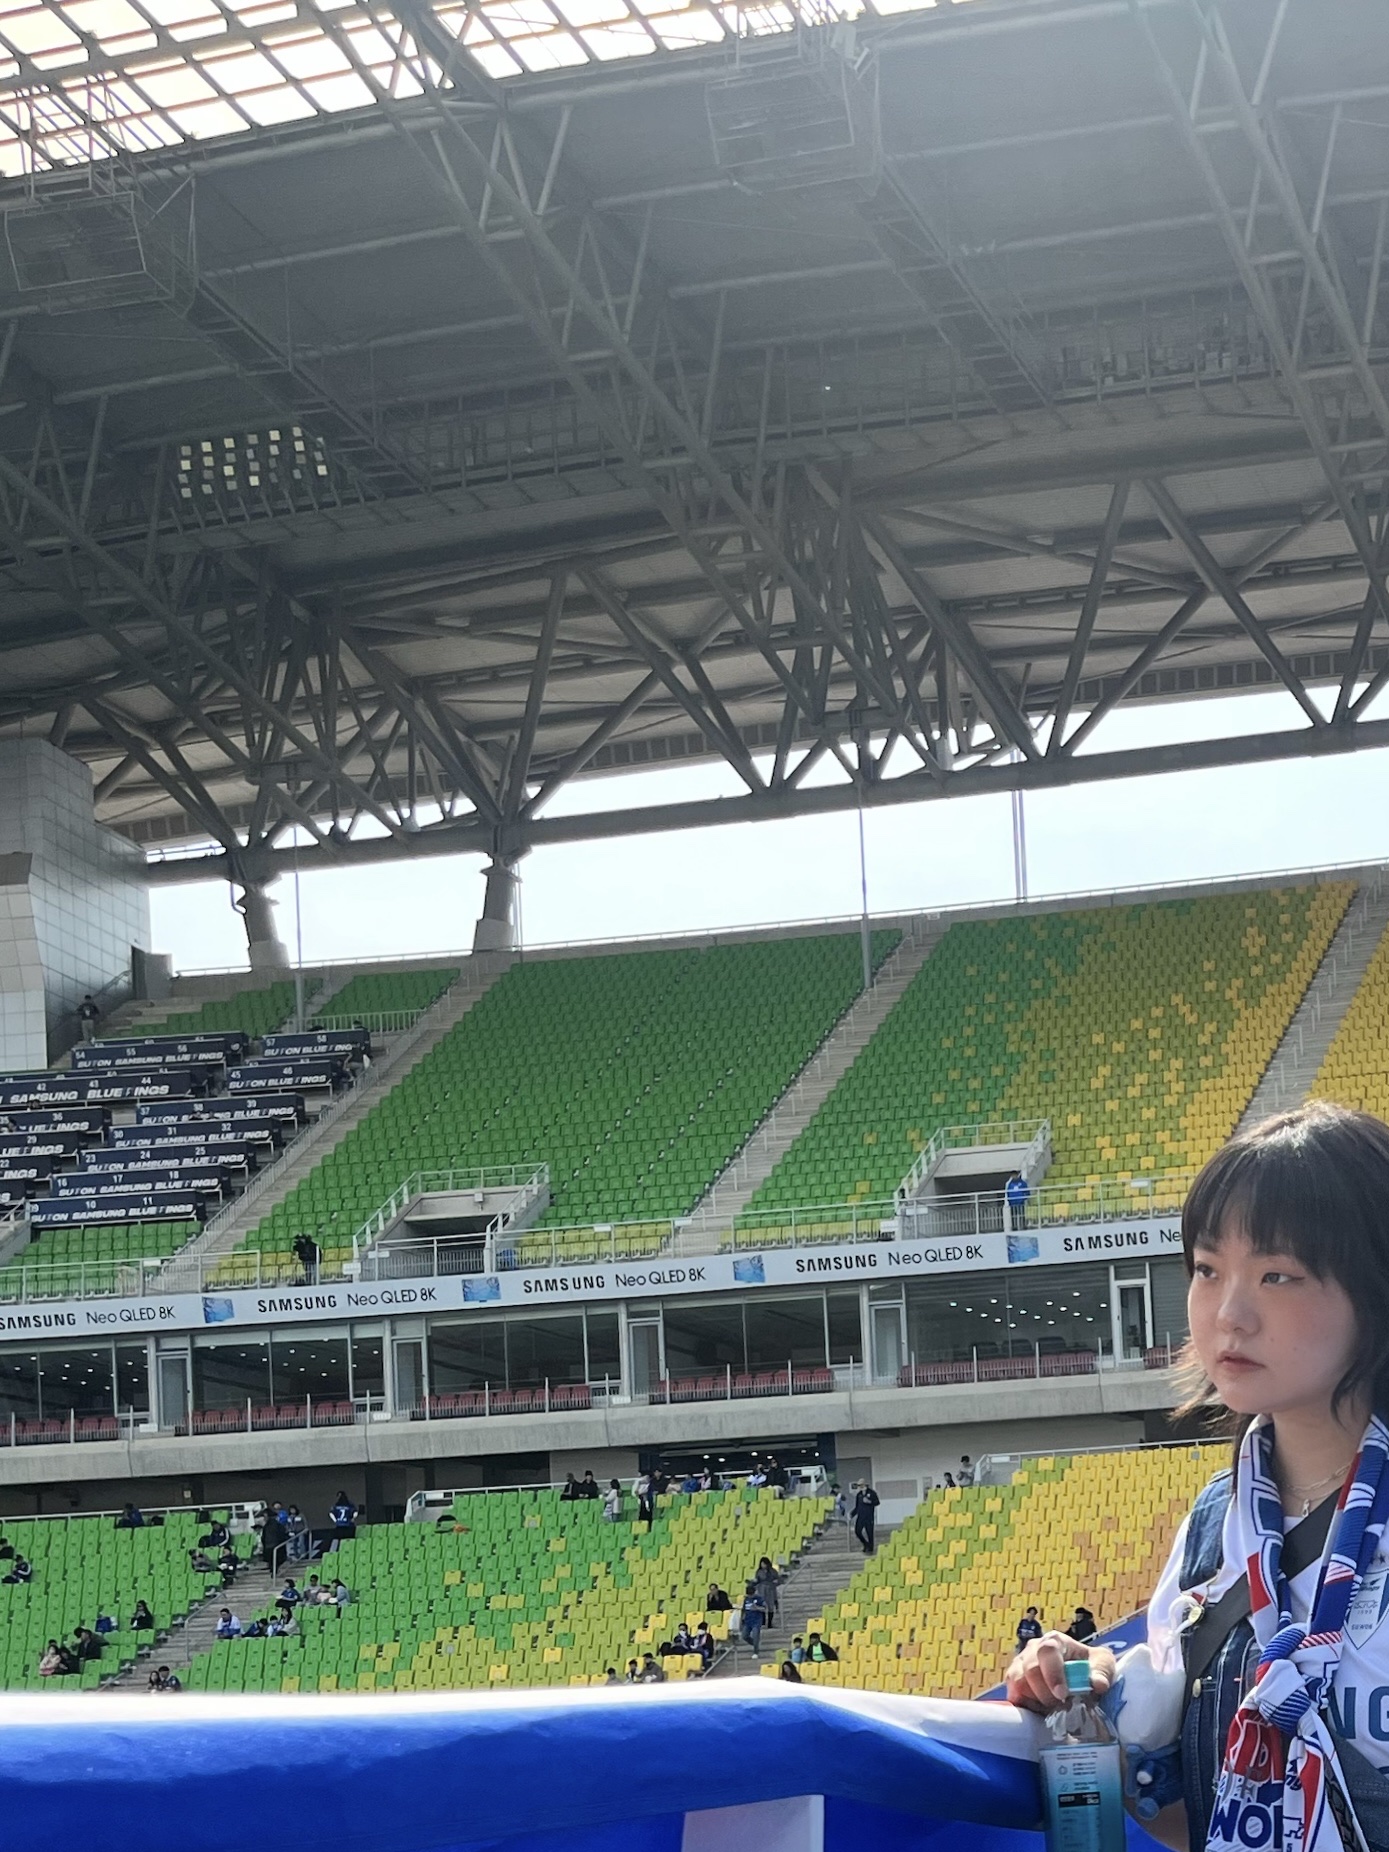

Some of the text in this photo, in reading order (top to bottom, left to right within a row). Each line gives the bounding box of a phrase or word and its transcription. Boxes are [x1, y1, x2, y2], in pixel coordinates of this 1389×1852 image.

[1063, 1228, 1182, 1252] SAMSUNG Ne
[796, 1244, 984, 1273] SAMSUNG Neo QLED 8K
[523, 1267, 706, 1293] SAMSUNG Neo QLED 8K
[257, 1287, 437, 1314] SAMSUNG Neo QLED 8K
[0, 1305, 176, 1330] SAMSUNG Neo QLED 8K
